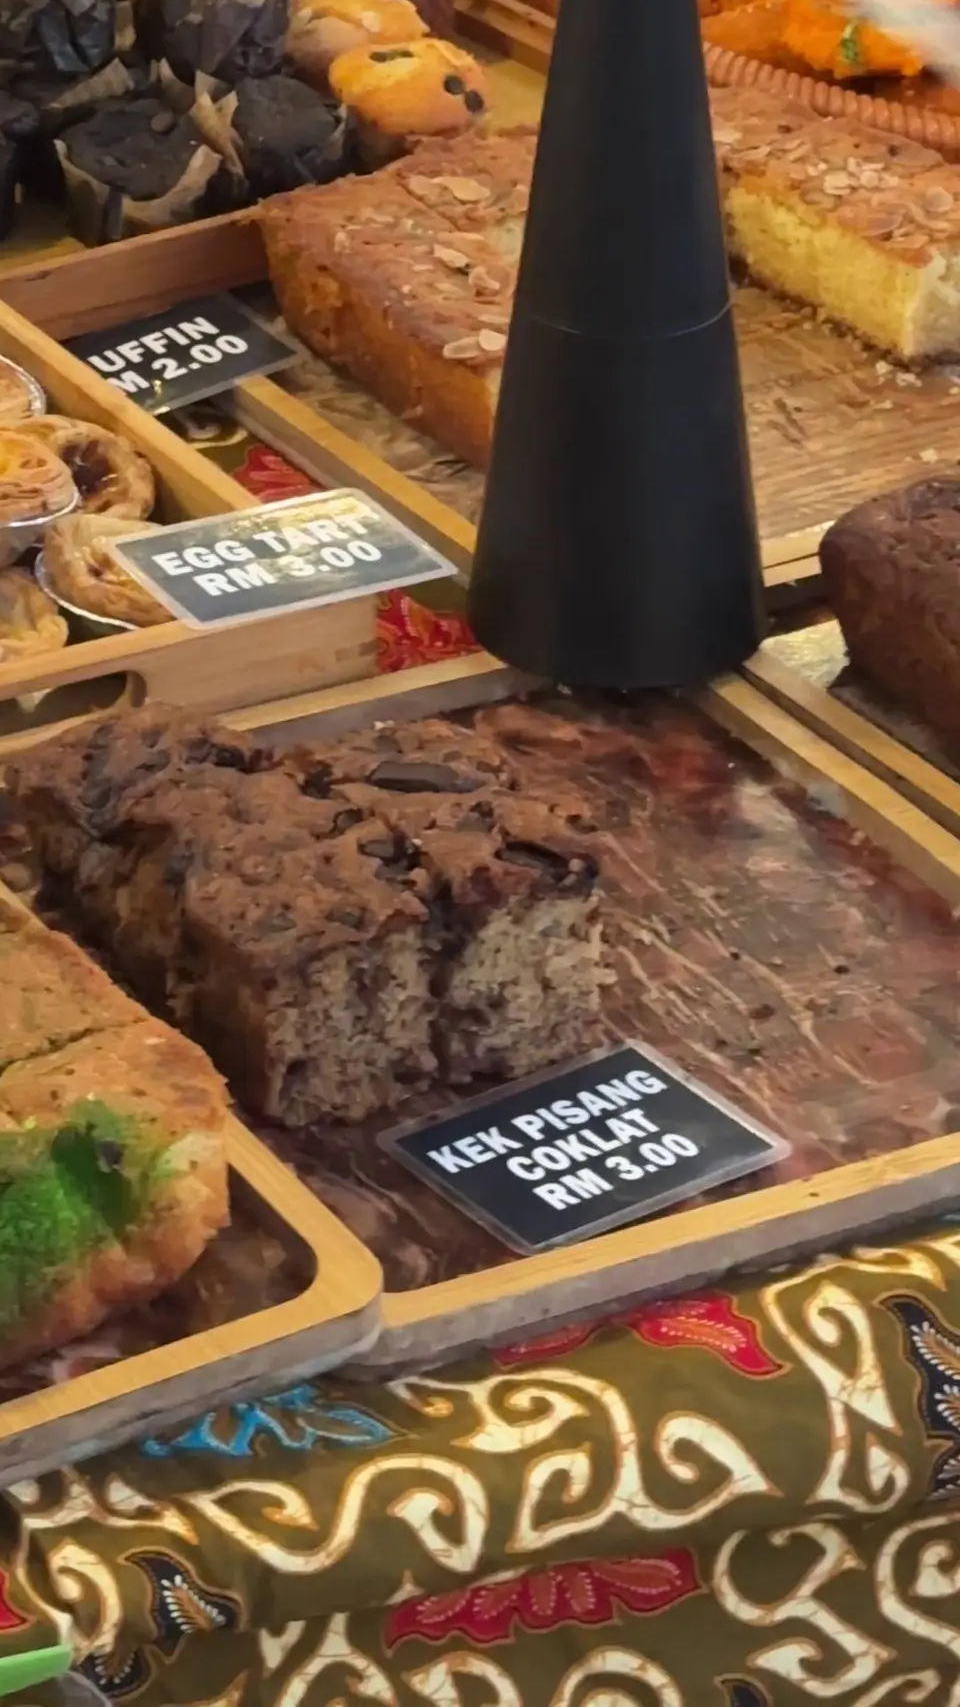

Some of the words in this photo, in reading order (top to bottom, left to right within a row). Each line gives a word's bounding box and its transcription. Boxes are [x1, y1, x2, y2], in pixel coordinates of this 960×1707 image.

[87, 316, 221, 373] UFFIN
[106, 370, 151, 393] M
[151, 335, 249, 380] 2.00
[152, 539, 256, 576] EGG
[253, 513, 370, 554] TART
[192, 563, 277, 597] RM
[280, 540, 382, 578] 3.00
[426, 1126, 524, 1174] KEK
[511, 1069, 668, 1141] PISANG
[506, 1108, 661, 1182] COKLAT
[532, 1166, 615, 1211] RM
[605, 1133, 700, 1181] 3.00
